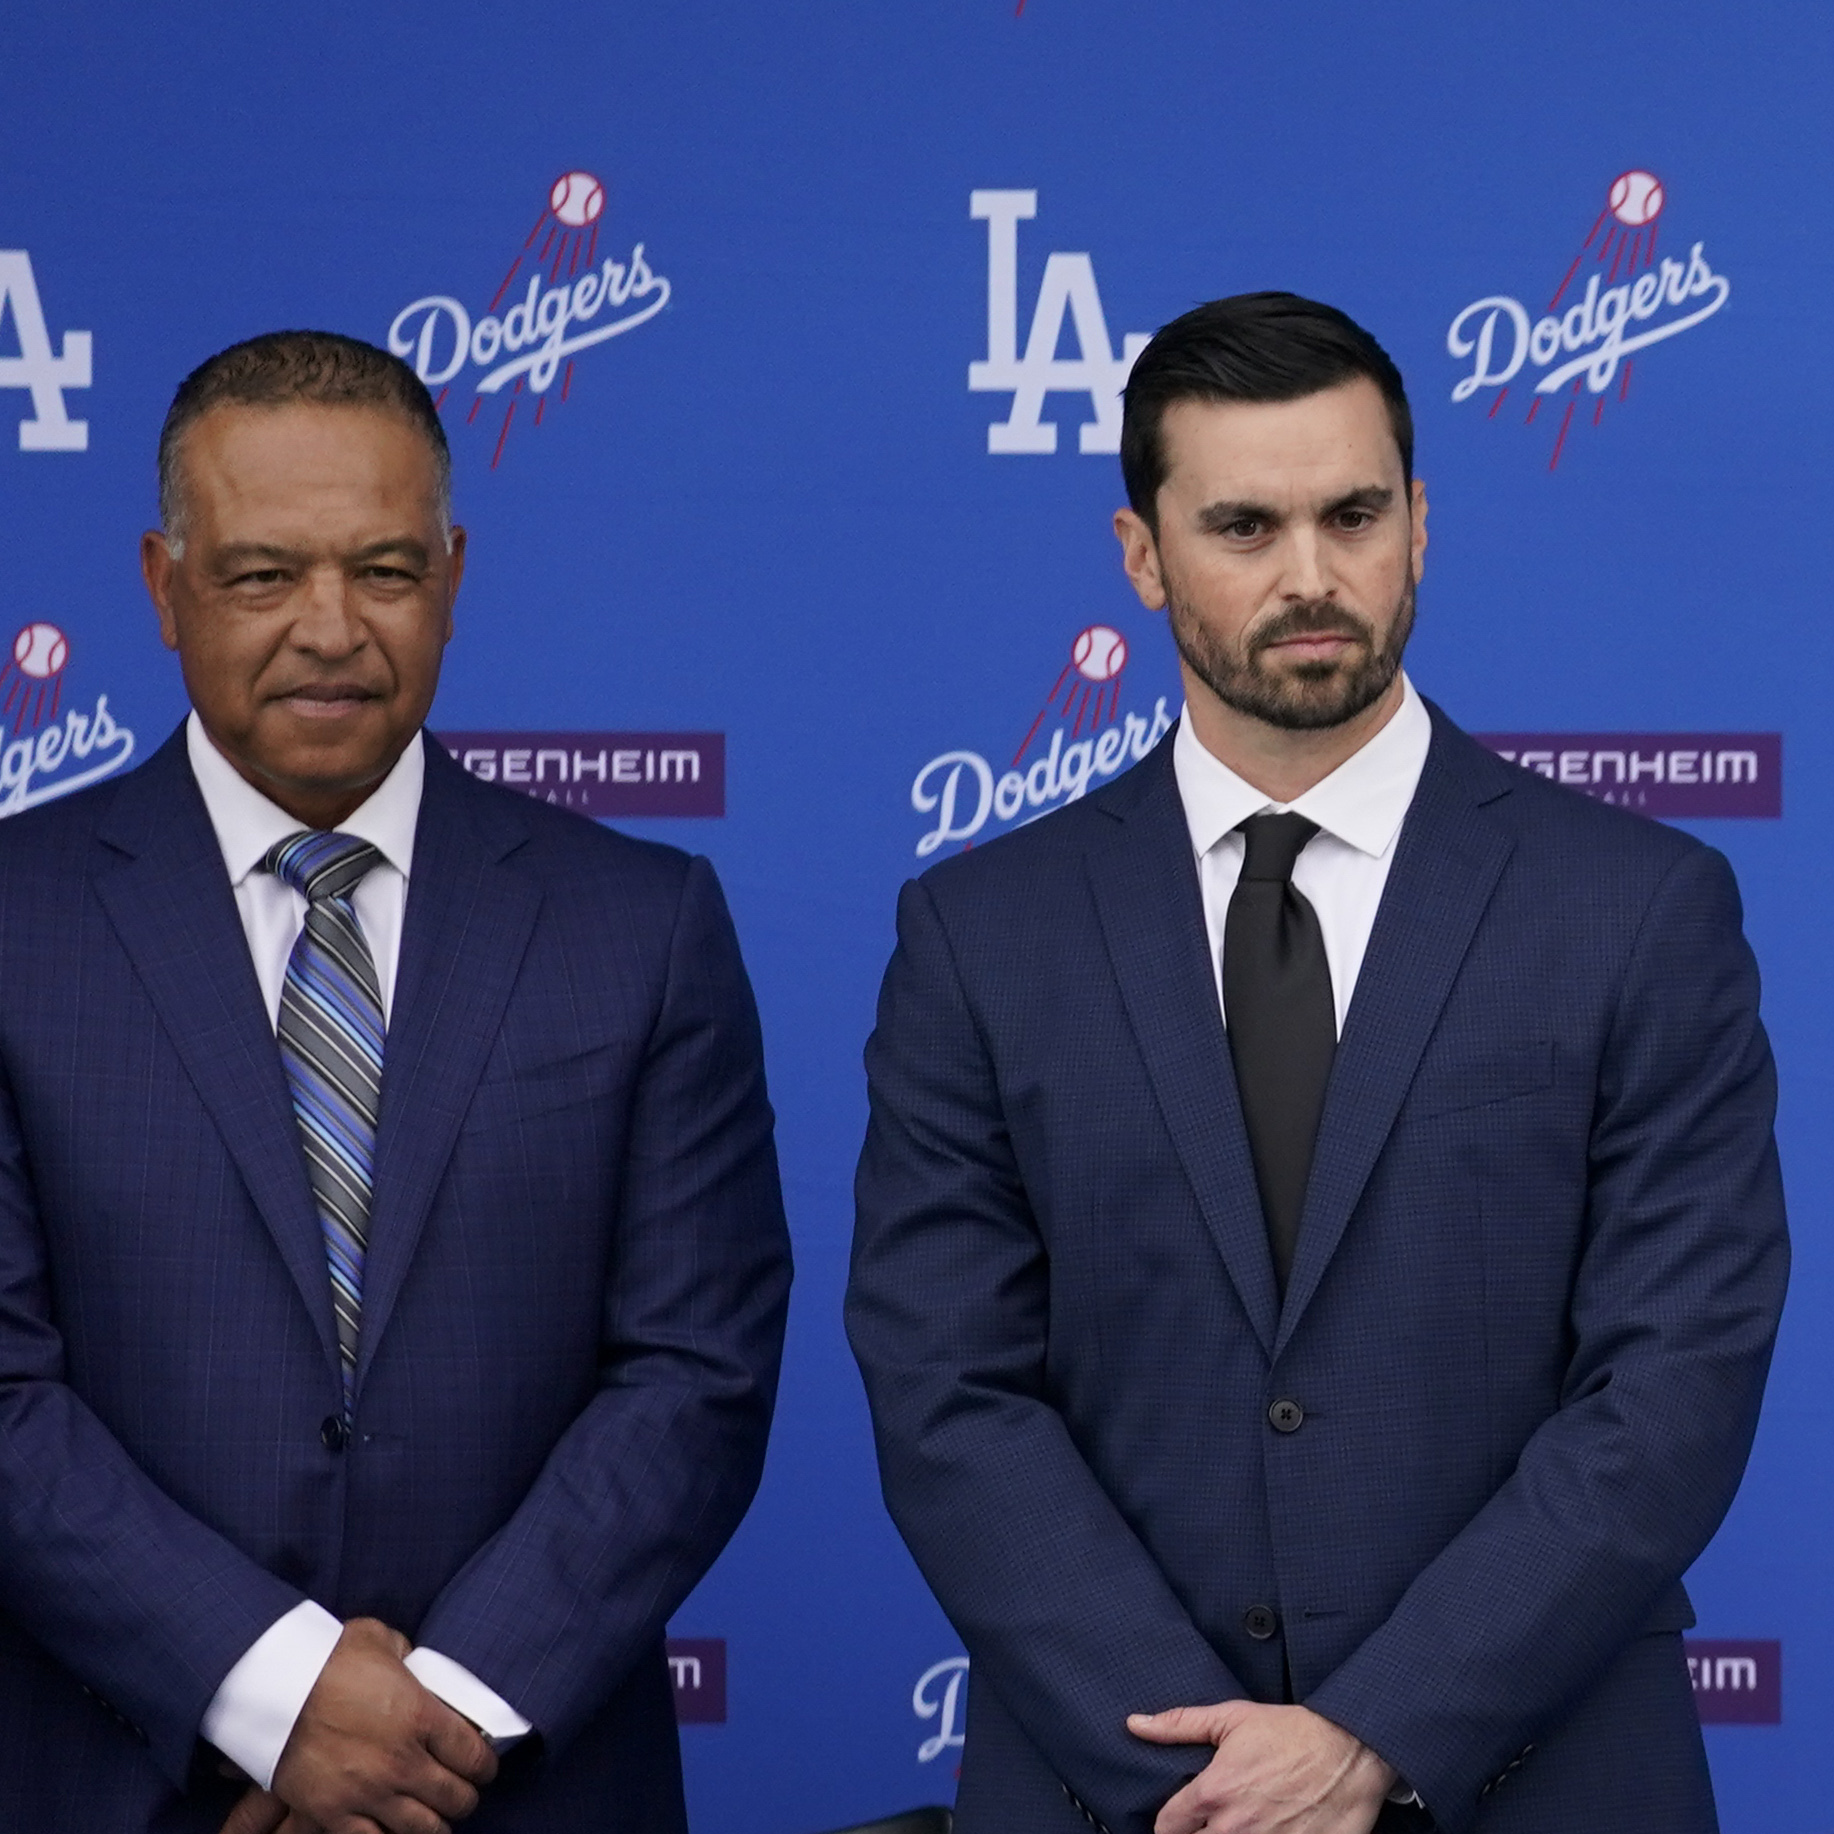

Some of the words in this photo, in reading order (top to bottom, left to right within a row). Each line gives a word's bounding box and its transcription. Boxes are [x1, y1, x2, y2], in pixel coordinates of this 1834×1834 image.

[388, 245, 670, 392] Dodgers
[969, 190, 1153, 454] LA
[1448, 242, 1729, 401] Dodgers
[451, 750, 699, 782] GENHEIM
[1499, 752, 1757, 782] ENHEIM
